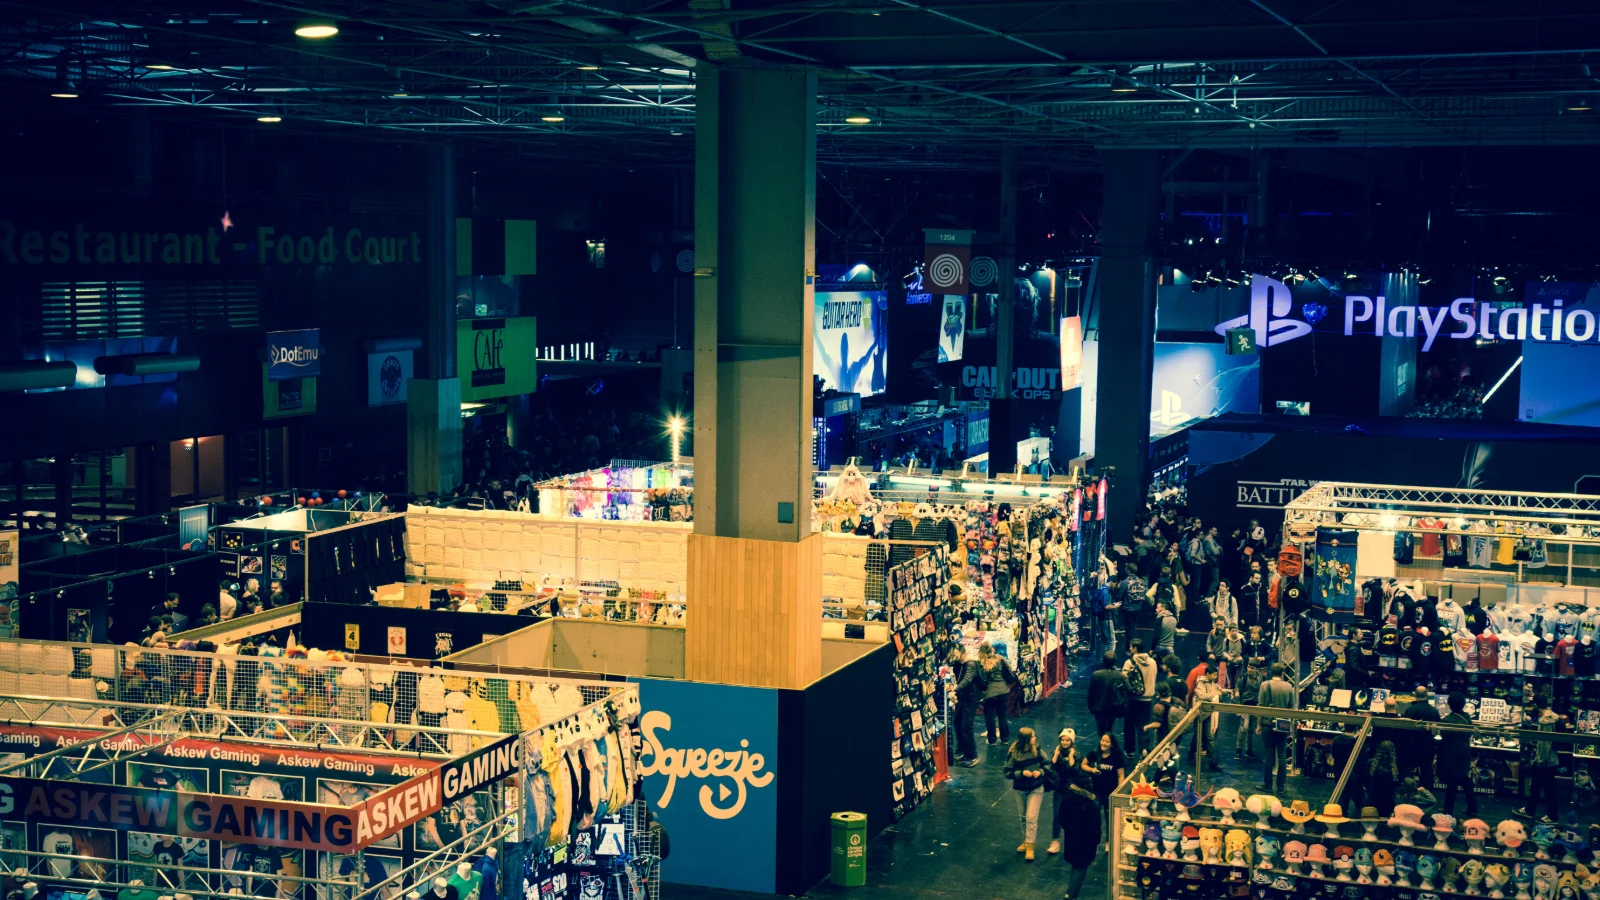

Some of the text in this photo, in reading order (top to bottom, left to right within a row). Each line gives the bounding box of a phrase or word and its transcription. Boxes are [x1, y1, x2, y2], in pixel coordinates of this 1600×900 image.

[257, 226, 335, 264] Food
[344, 228, 422, 264] Court
[822, 301, 863, 330] GUITAR HERO
[1343, 295, 1600, 353] PlayStatio
[280, 346, 319, 362] DotEmu
[1017, 367, 1060, 390] DUT
[1023, 389, 1051, 400] OPS
[1280, 478, 1308, 487] STAR
[164, 745, 208, 759] Askew
[210, 746, 260, 766] Gaming
[277, 754, 320, 768] Askew
[323, 756, 375, 775] Gaming
[638, 710, 775, 820] Squeezie
[25, 786, 171, 828] ASKEW
[184, 802, 352, 846] GAMING
[356, 776, 441, 844] ASKEW
